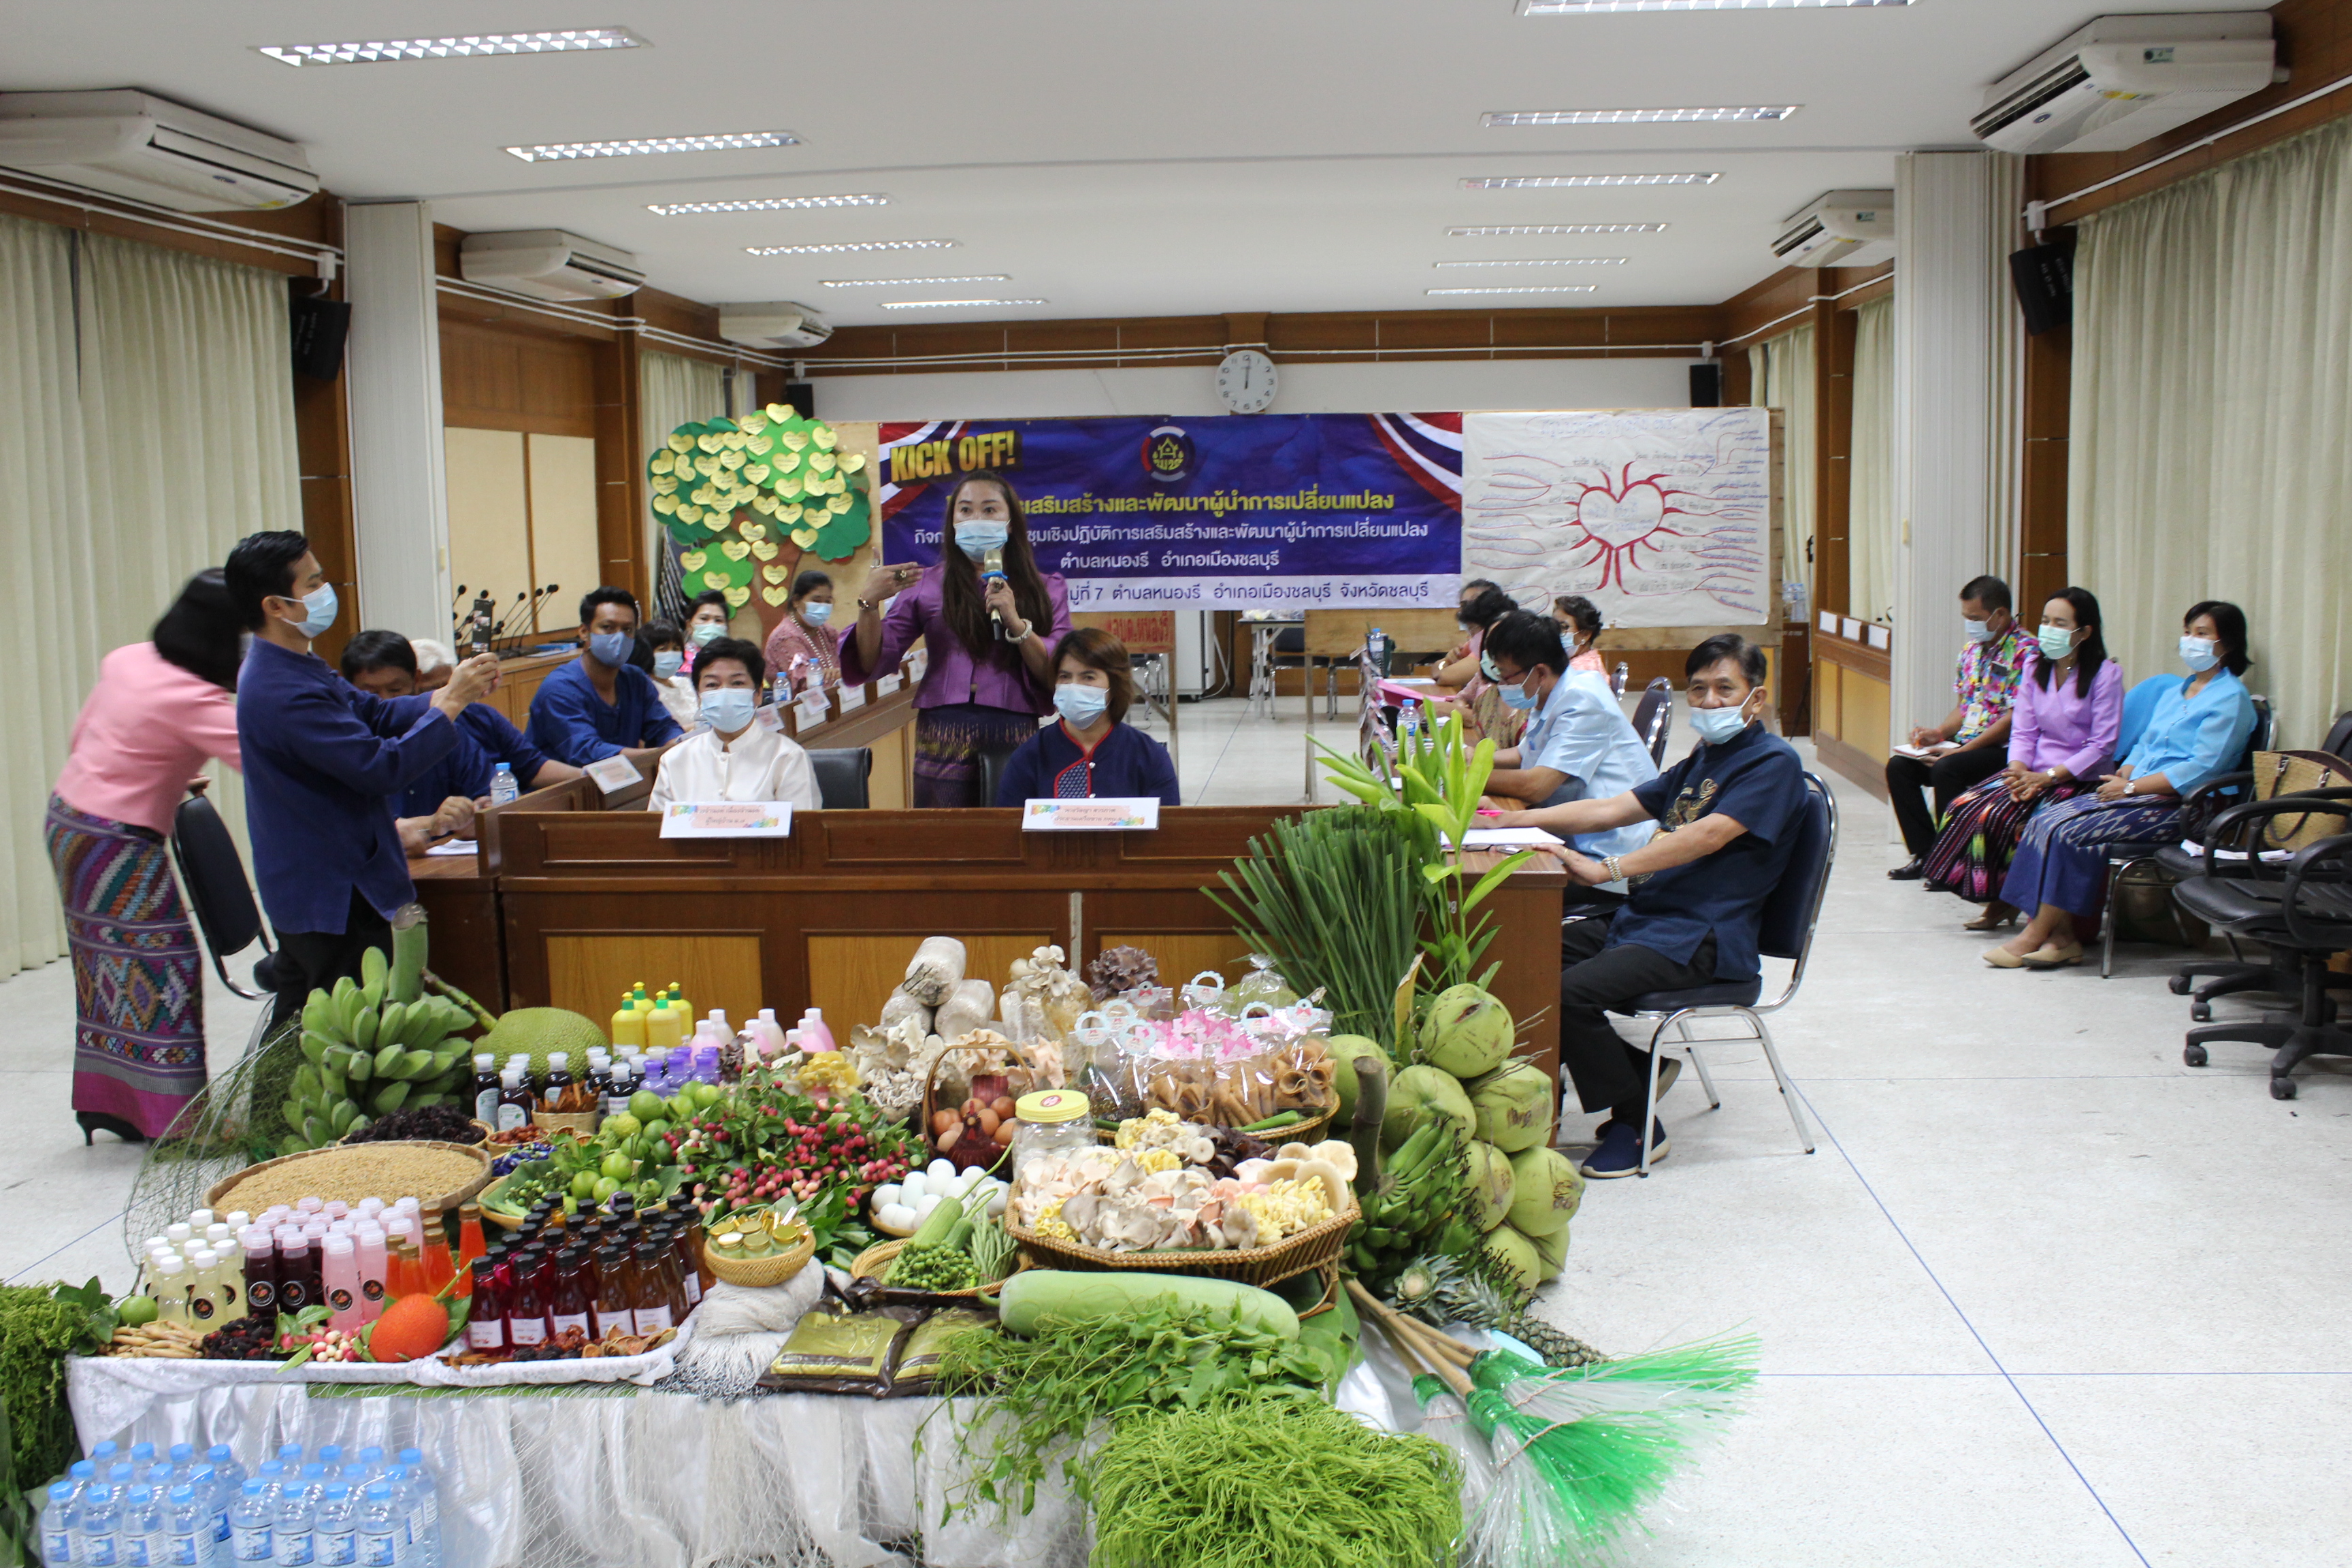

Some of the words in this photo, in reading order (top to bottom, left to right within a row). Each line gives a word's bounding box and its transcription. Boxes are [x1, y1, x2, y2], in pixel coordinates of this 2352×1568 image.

[890, 439, 953, 483] KICK
[959, 429, 1016, 472] OFF!
[1060, 551, 1149, 568] ตำบลหนองรี
[1161, 549, 1279, 570] อำเภอเมืองชลบุรี
[1094, 587, 1103, 600] 7
[1113, 584, 1200, 600] ตำบลหนองรี
[1214, 582, 1331, 603] อำเภอเมืองชลบุรี
[1340, 582, 1428, 602] จังหวัดชลบุรี
